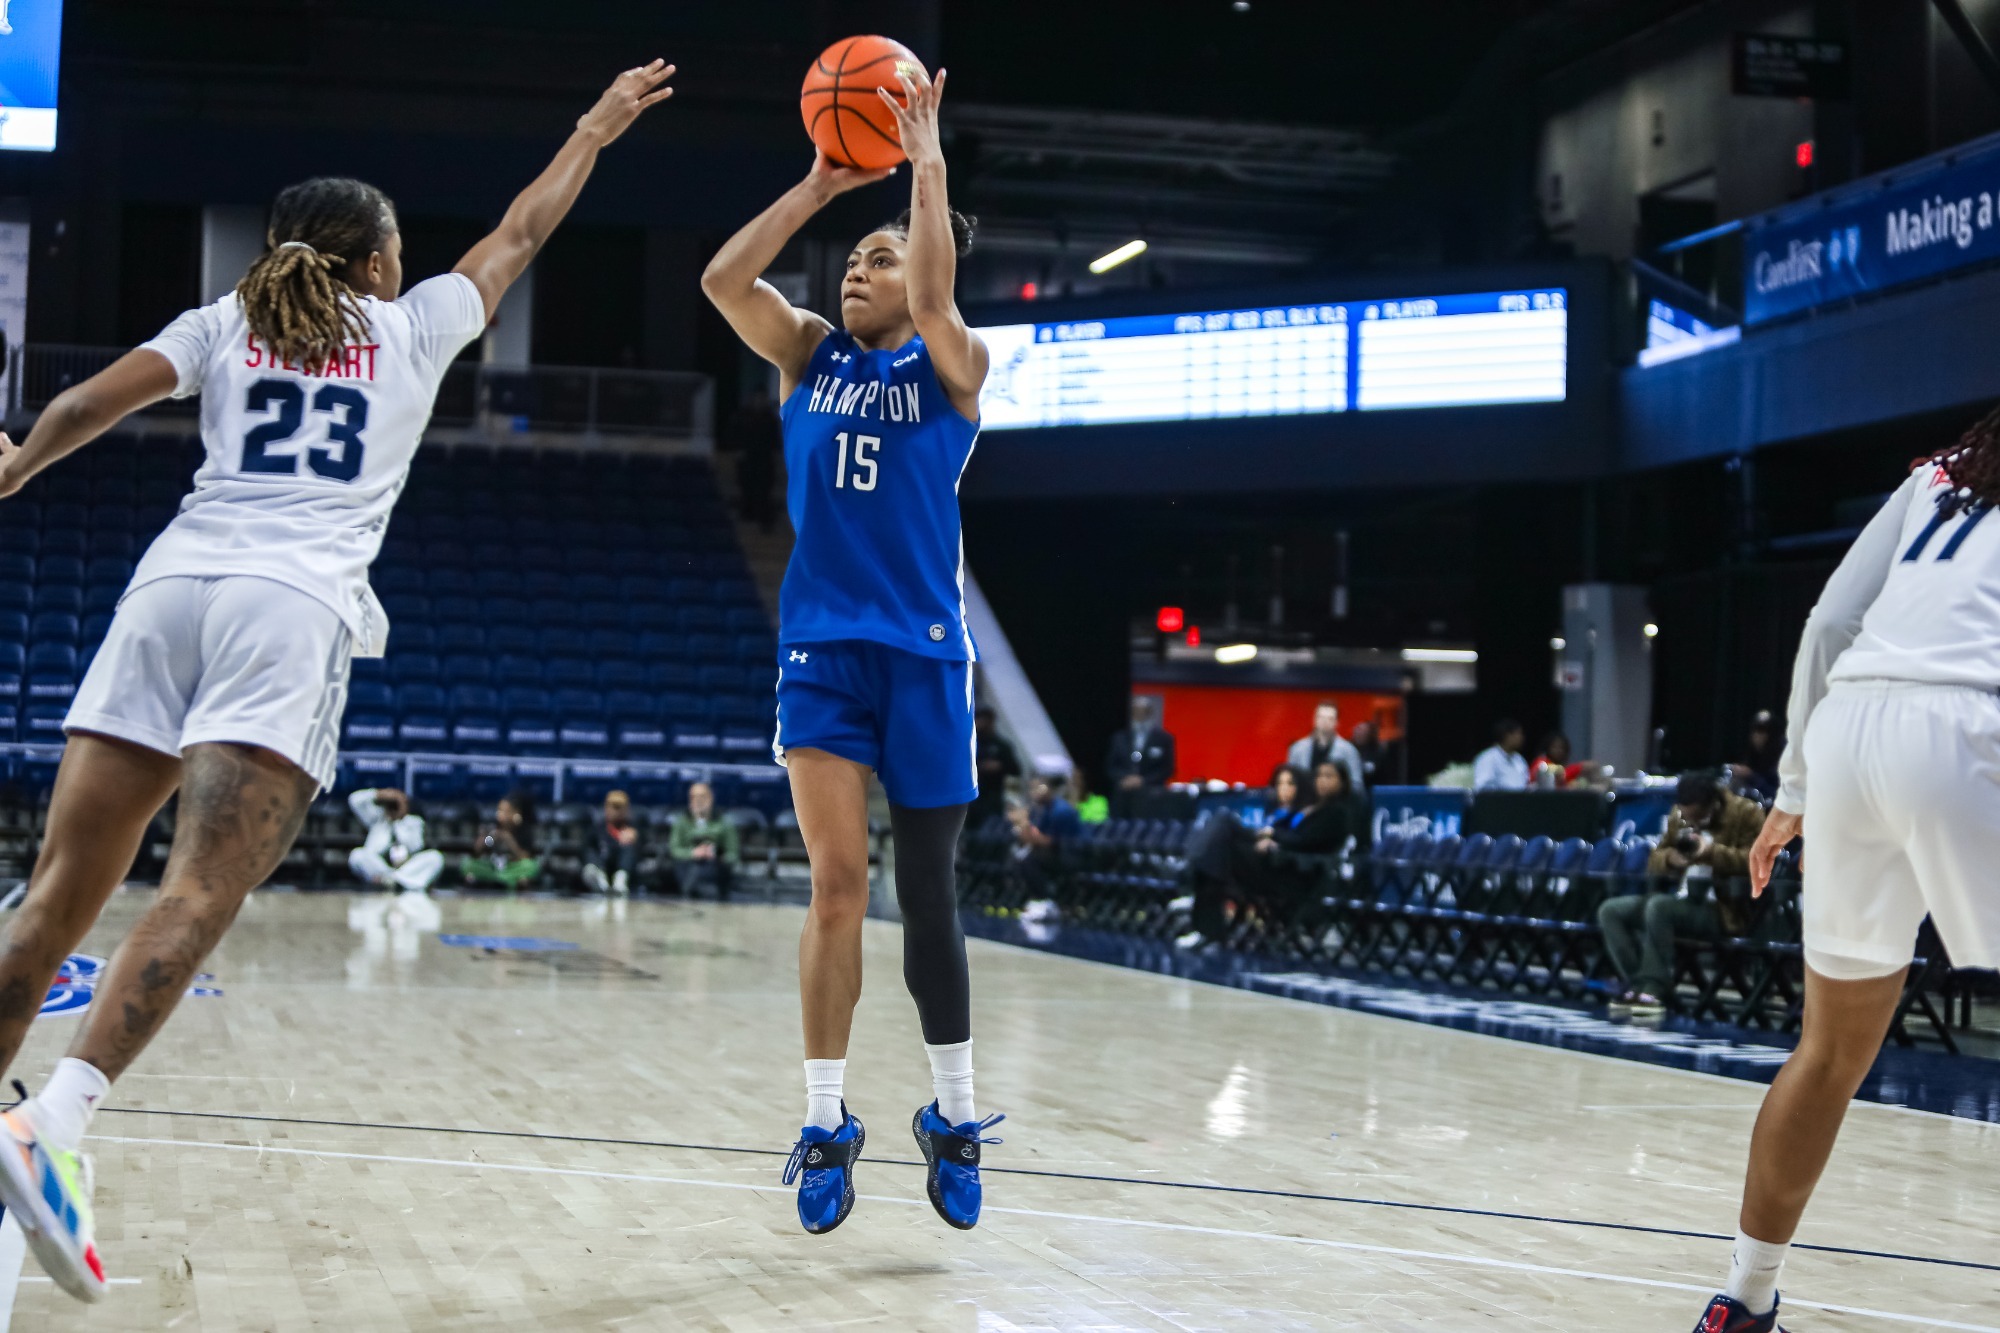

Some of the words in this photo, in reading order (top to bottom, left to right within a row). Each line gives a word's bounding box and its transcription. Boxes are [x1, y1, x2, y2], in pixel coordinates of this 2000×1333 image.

[1887, 195, 1973, 257] Making
[1978, 192, 1992, 230] a
[238, 377, 370, 484] 23
[835, 432, 881, 491] 15
